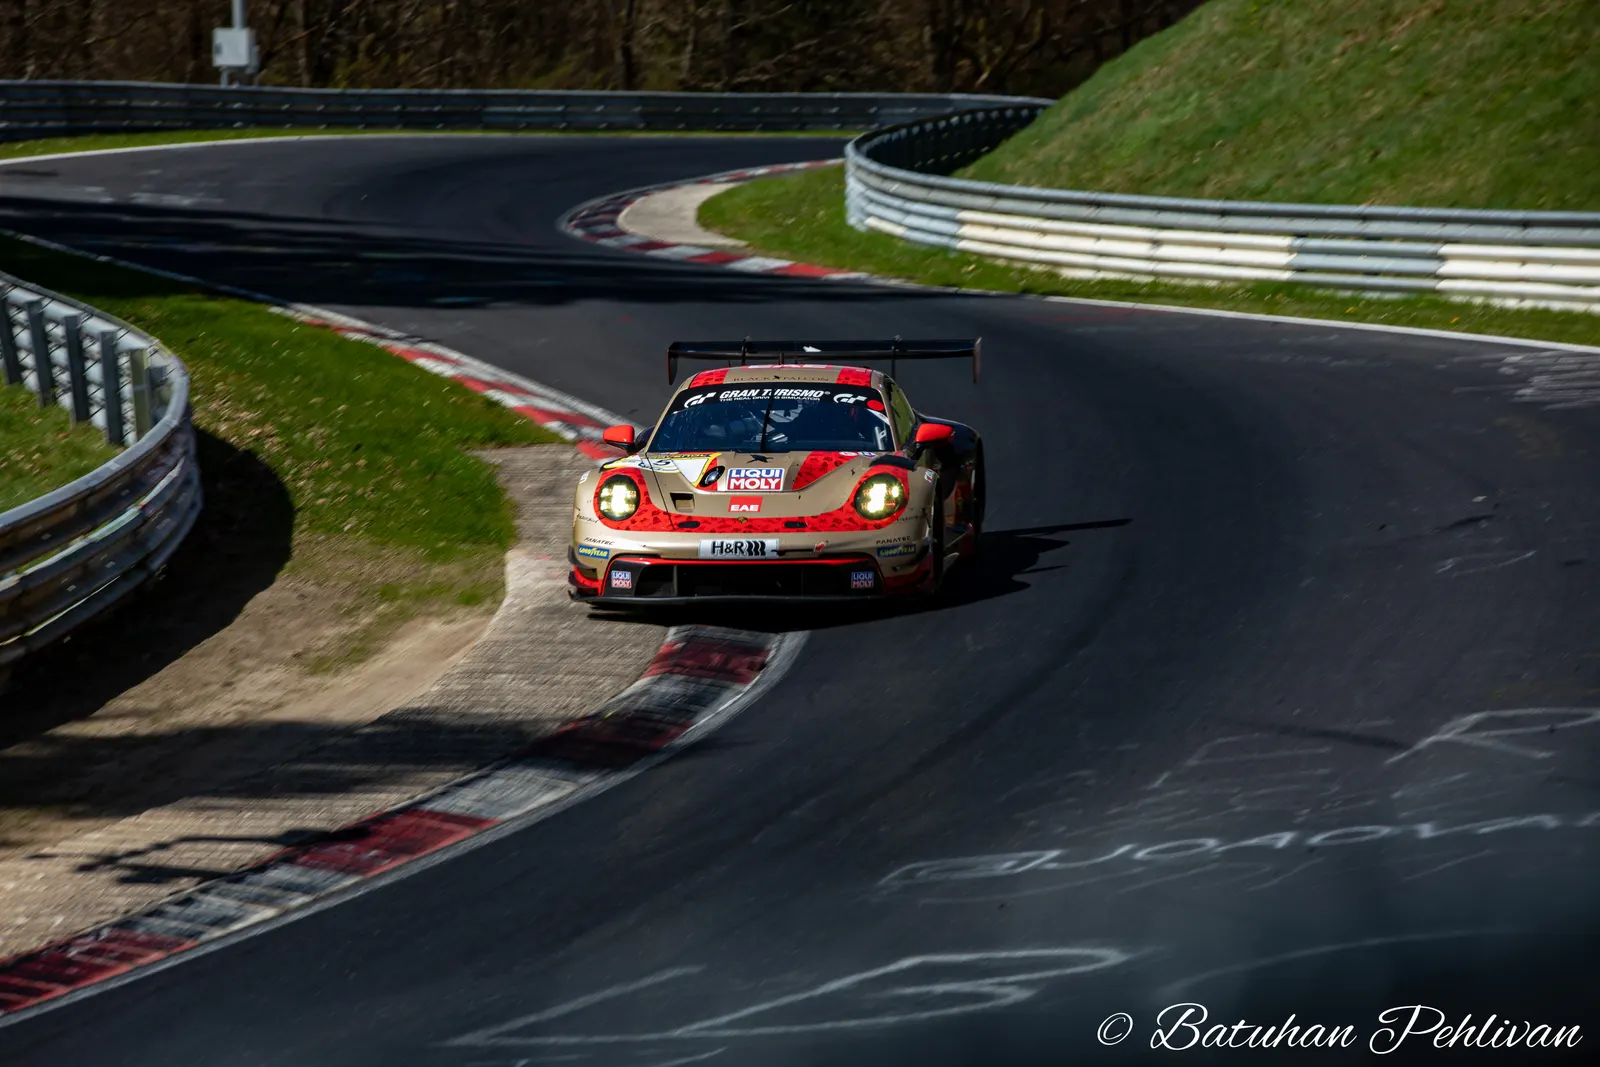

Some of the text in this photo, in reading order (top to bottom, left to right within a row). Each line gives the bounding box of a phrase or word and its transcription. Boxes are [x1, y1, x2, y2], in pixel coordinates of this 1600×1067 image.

[719, 389, 761, 399] GRAN
[731, 469, 781, 478] LIQUI
[729, 478, 780, 490] MOLY
[730, 504, 760, 512] EAE
[584, 536, 616, 546] FANATEC
[876, 535, 911, 545] FANATEC
[711, 541, 745, 555] H&R
[613, 572, 631, 580] LIQUI
[852, 572, 873, 580] LIQUI
[612, 580, 632, 589] MOLY
[852, 580, 873, 588] MOLY
